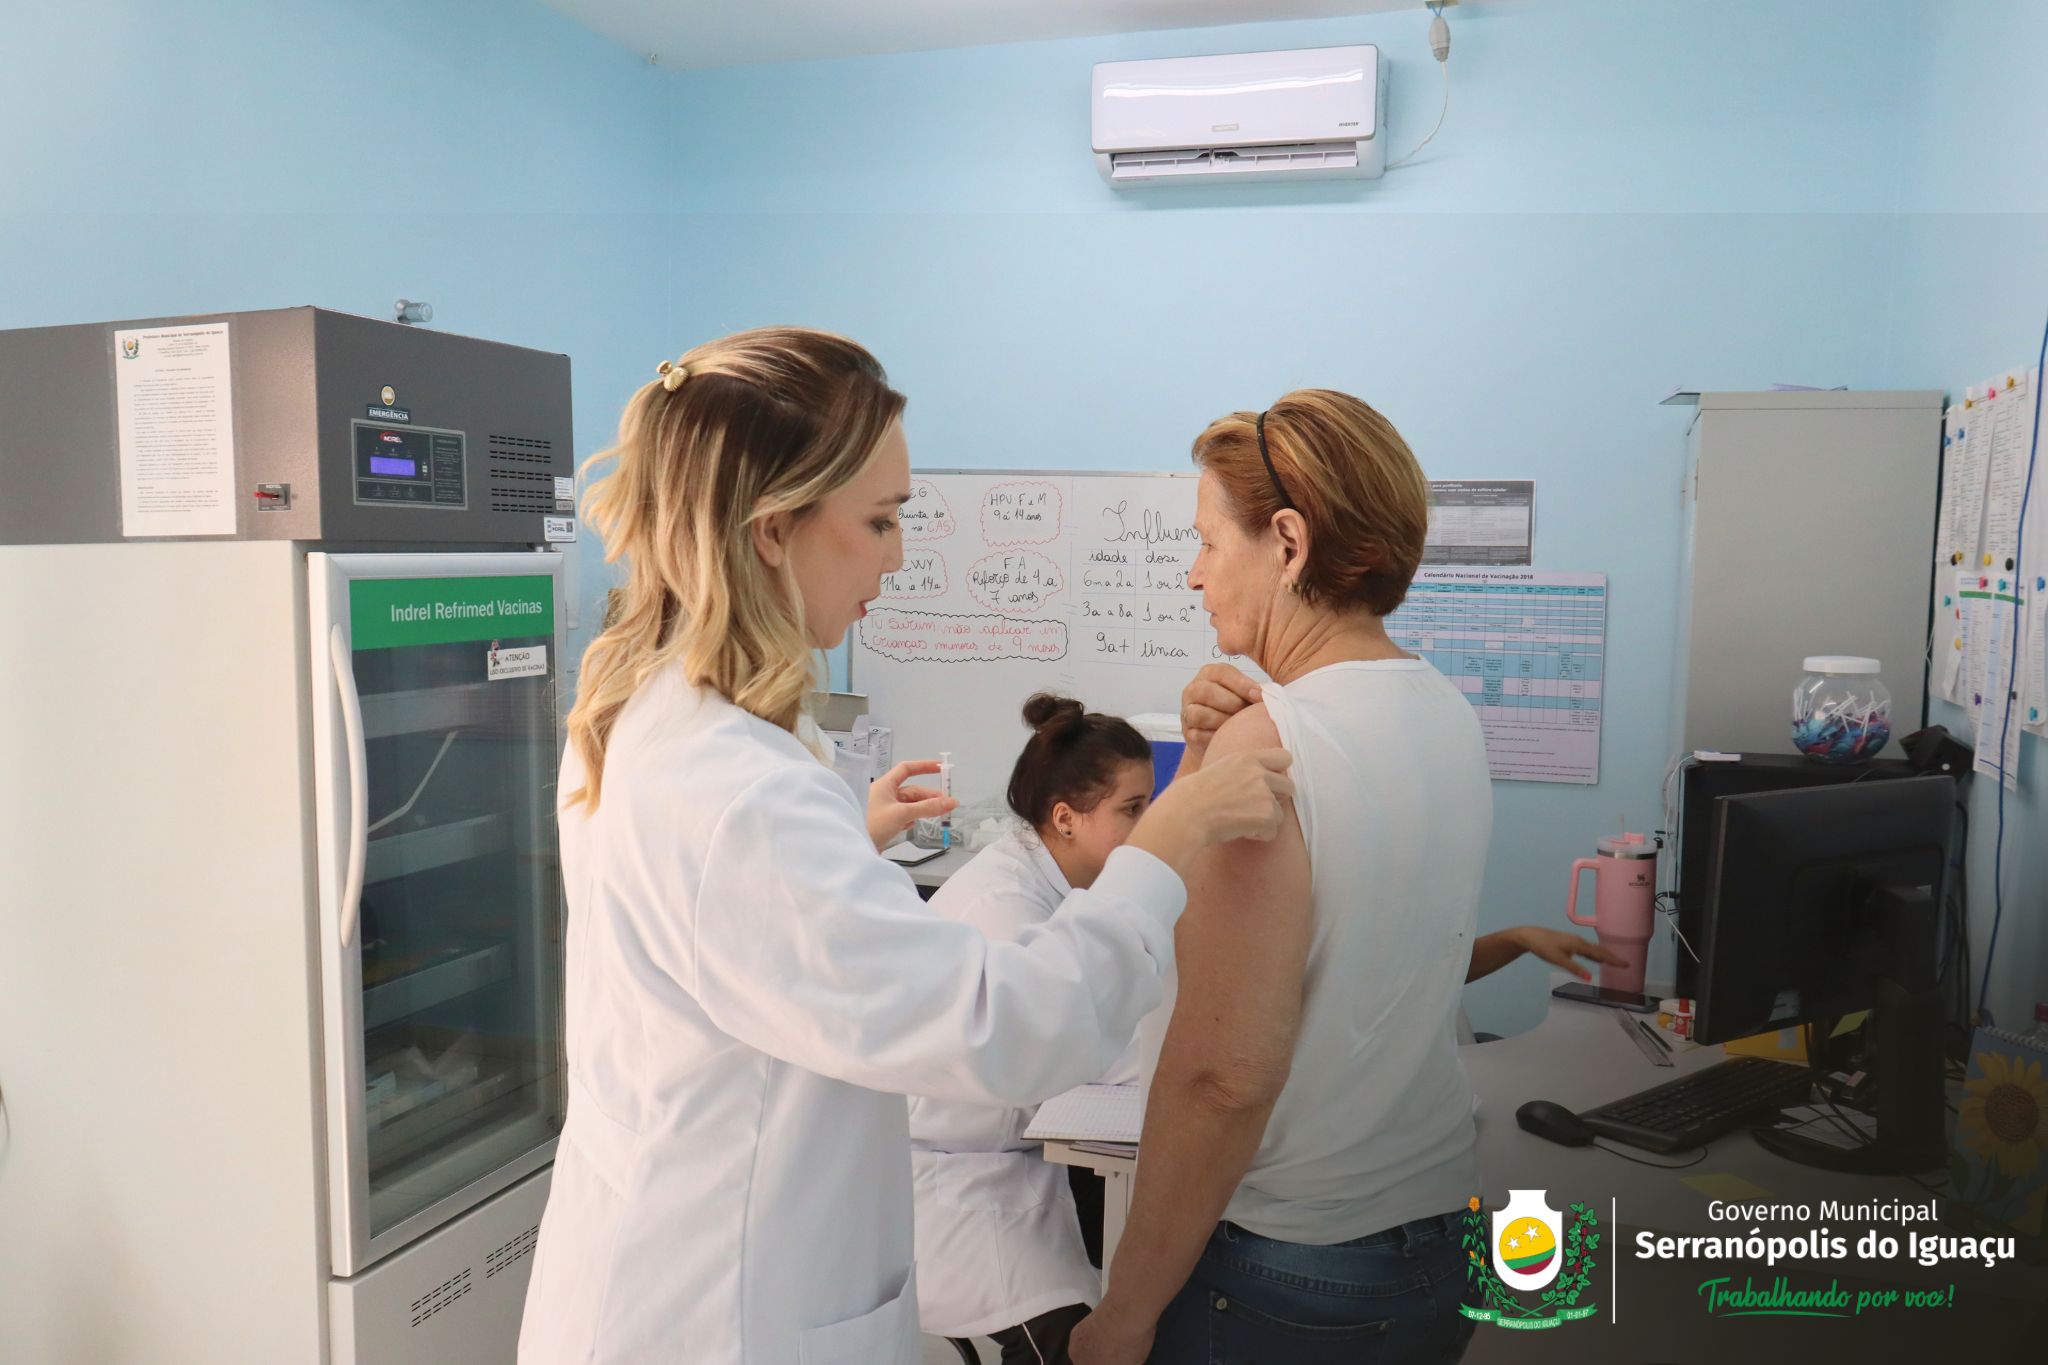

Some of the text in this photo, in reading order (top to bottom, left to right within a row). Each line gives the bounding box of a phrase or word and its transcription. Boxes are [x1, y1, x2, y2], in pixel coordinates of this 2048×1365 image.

[368, 408, 409, 420] EMERGÊNCIA
[910, 486, 928, 499] CG
[989, 493, 1012, 506] HPV
[1019, 492, 1026, 506] F
[1037, 491, 1047, 505] M
[993, 509, 1001, 521] 9
[1014, 507, 1025, 521] 14
[1102, 500, 1200, 551] Influen
[1003, 555, 1027, 570] F A
[1088, 550, 1180, 565] idade dose
[1014, 570, 1029, 584] de
[1032, 568, 1040, 585] 4
[1490, 573, 1519, 582] Vacinação
[1156, 579, 1173, 591] ou
[989, 589, 1039, 605] 7 anos
[390, 599, 543, 623] Indrel Refrimed Vacinas
[1082, 600, 1102, 617] 3a
[1157, 613, 1175, 622] ou
[505, 651, 530, 662] ATENÇÃO
